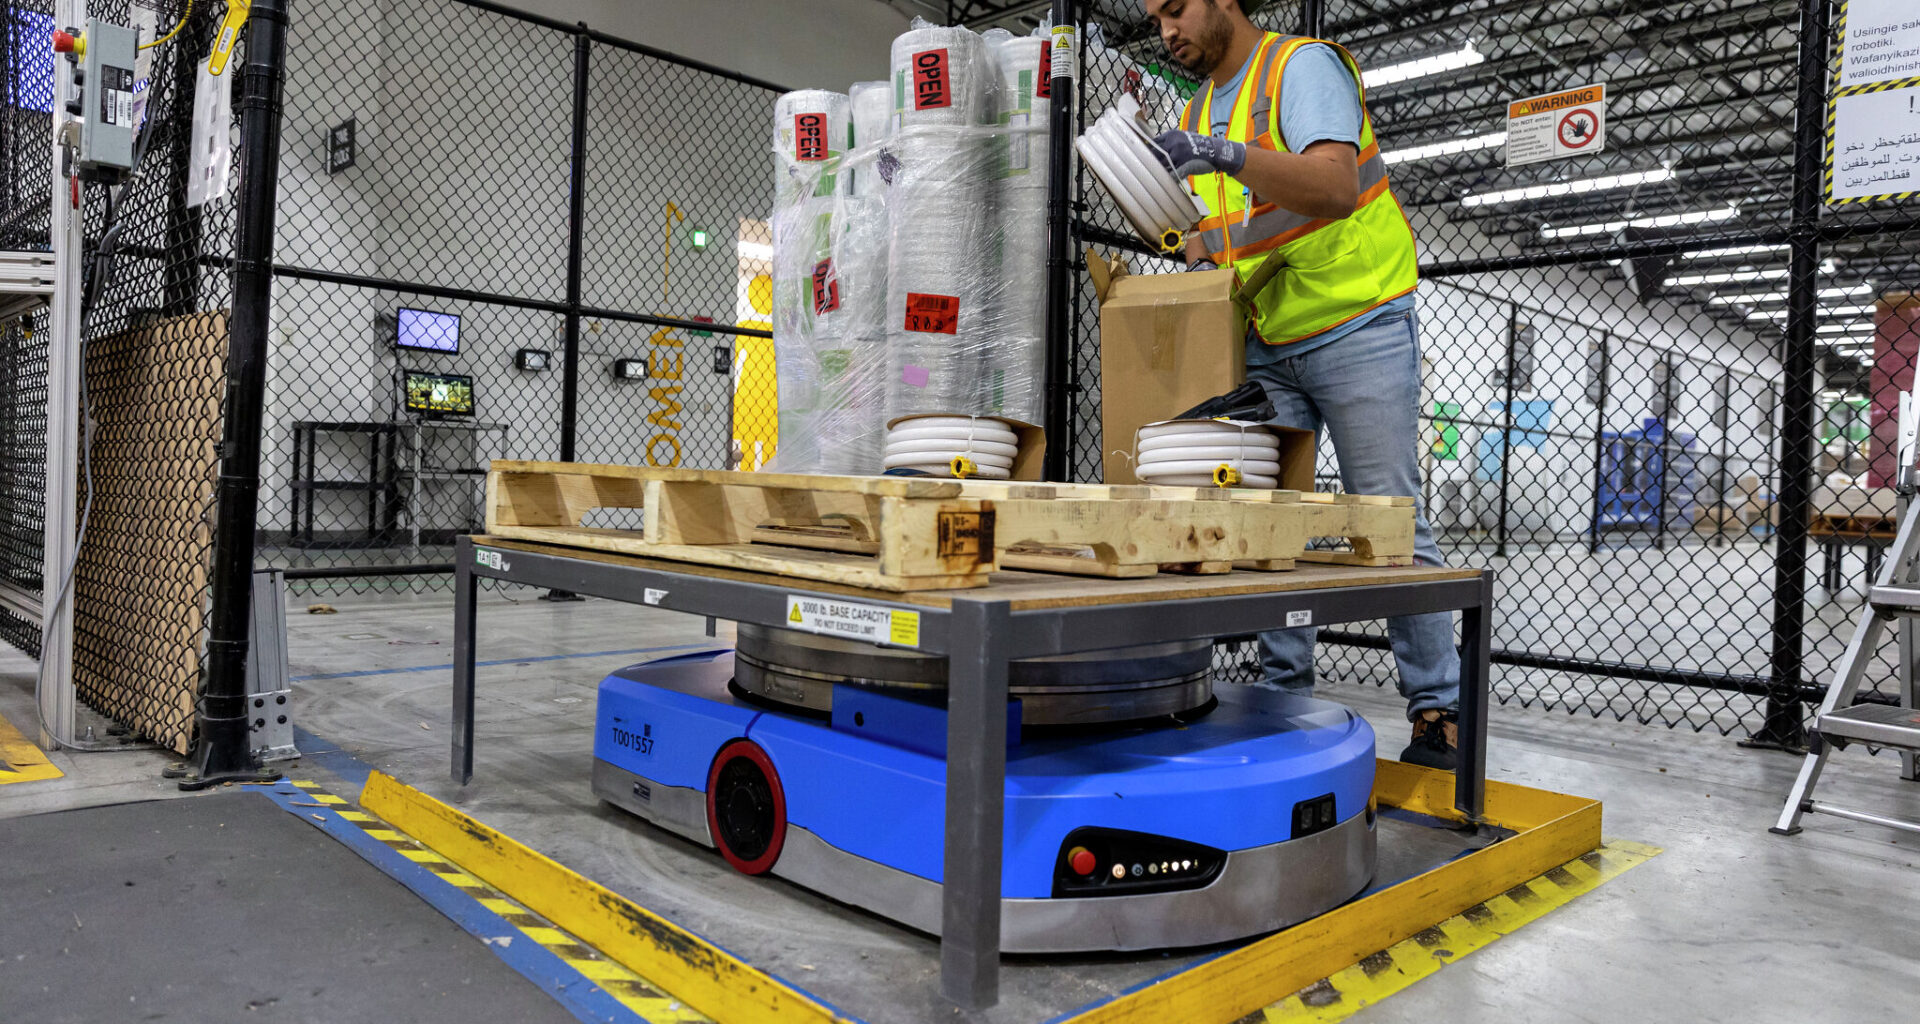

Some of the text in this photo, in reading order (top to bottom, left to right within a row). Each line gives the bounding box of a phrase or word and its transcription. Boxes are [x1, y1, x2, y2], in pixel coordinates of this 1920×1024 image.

[1853, 24, 1898, 38] Usiingie
[1851, 37, 1895, 52] robotiki.
[1851, 46, 1919, 65] Wafanyikazi
[918, 53, 943, 107] OPEN
[1531, 90, 1593, 112] WARNING
[1521, 118, 1533, 126] NOT
[800, 115, 821, 159] OPEN
[802, 602, 818, 614] 3000
[829, 605, 849, 619] BASE
[851, 608, 890, 624] CAPACITY
[824, 620, 835, 629] NOT
[836, 621, 859, 633] EXCEED
[860, 625, 875, 635] LIMIT
[612, 727, 654, 755] T001557
